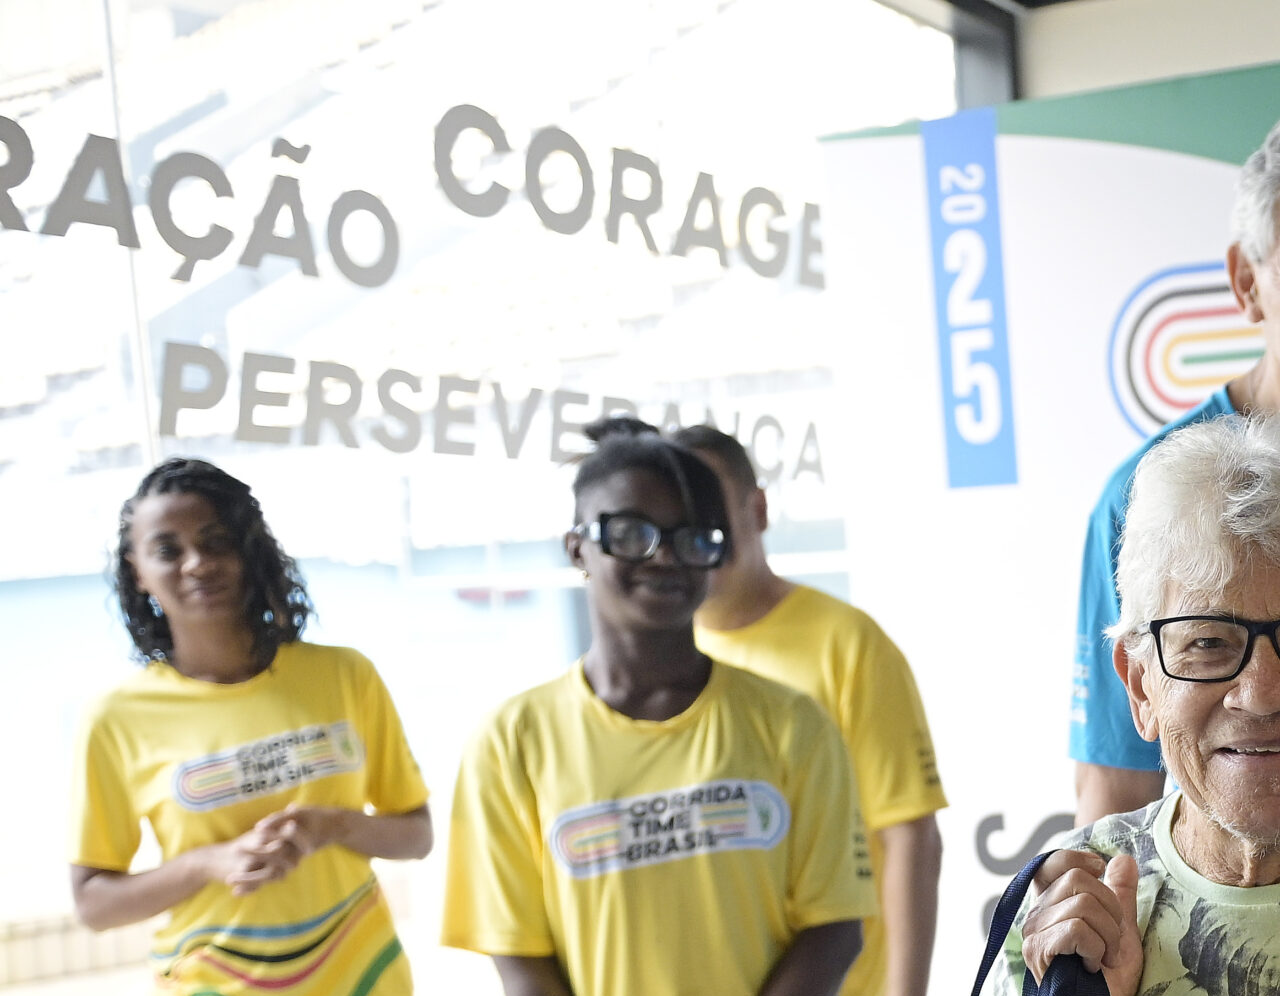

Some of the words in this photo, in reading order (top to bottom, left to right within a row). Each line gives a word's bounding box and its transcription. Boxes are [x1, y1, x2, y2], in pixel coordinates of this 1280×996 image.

[939, 163, 1003, 446] 2025
[629, 784, 748, 817] CORRIDA
[630, 812, 692, 838] TIME
